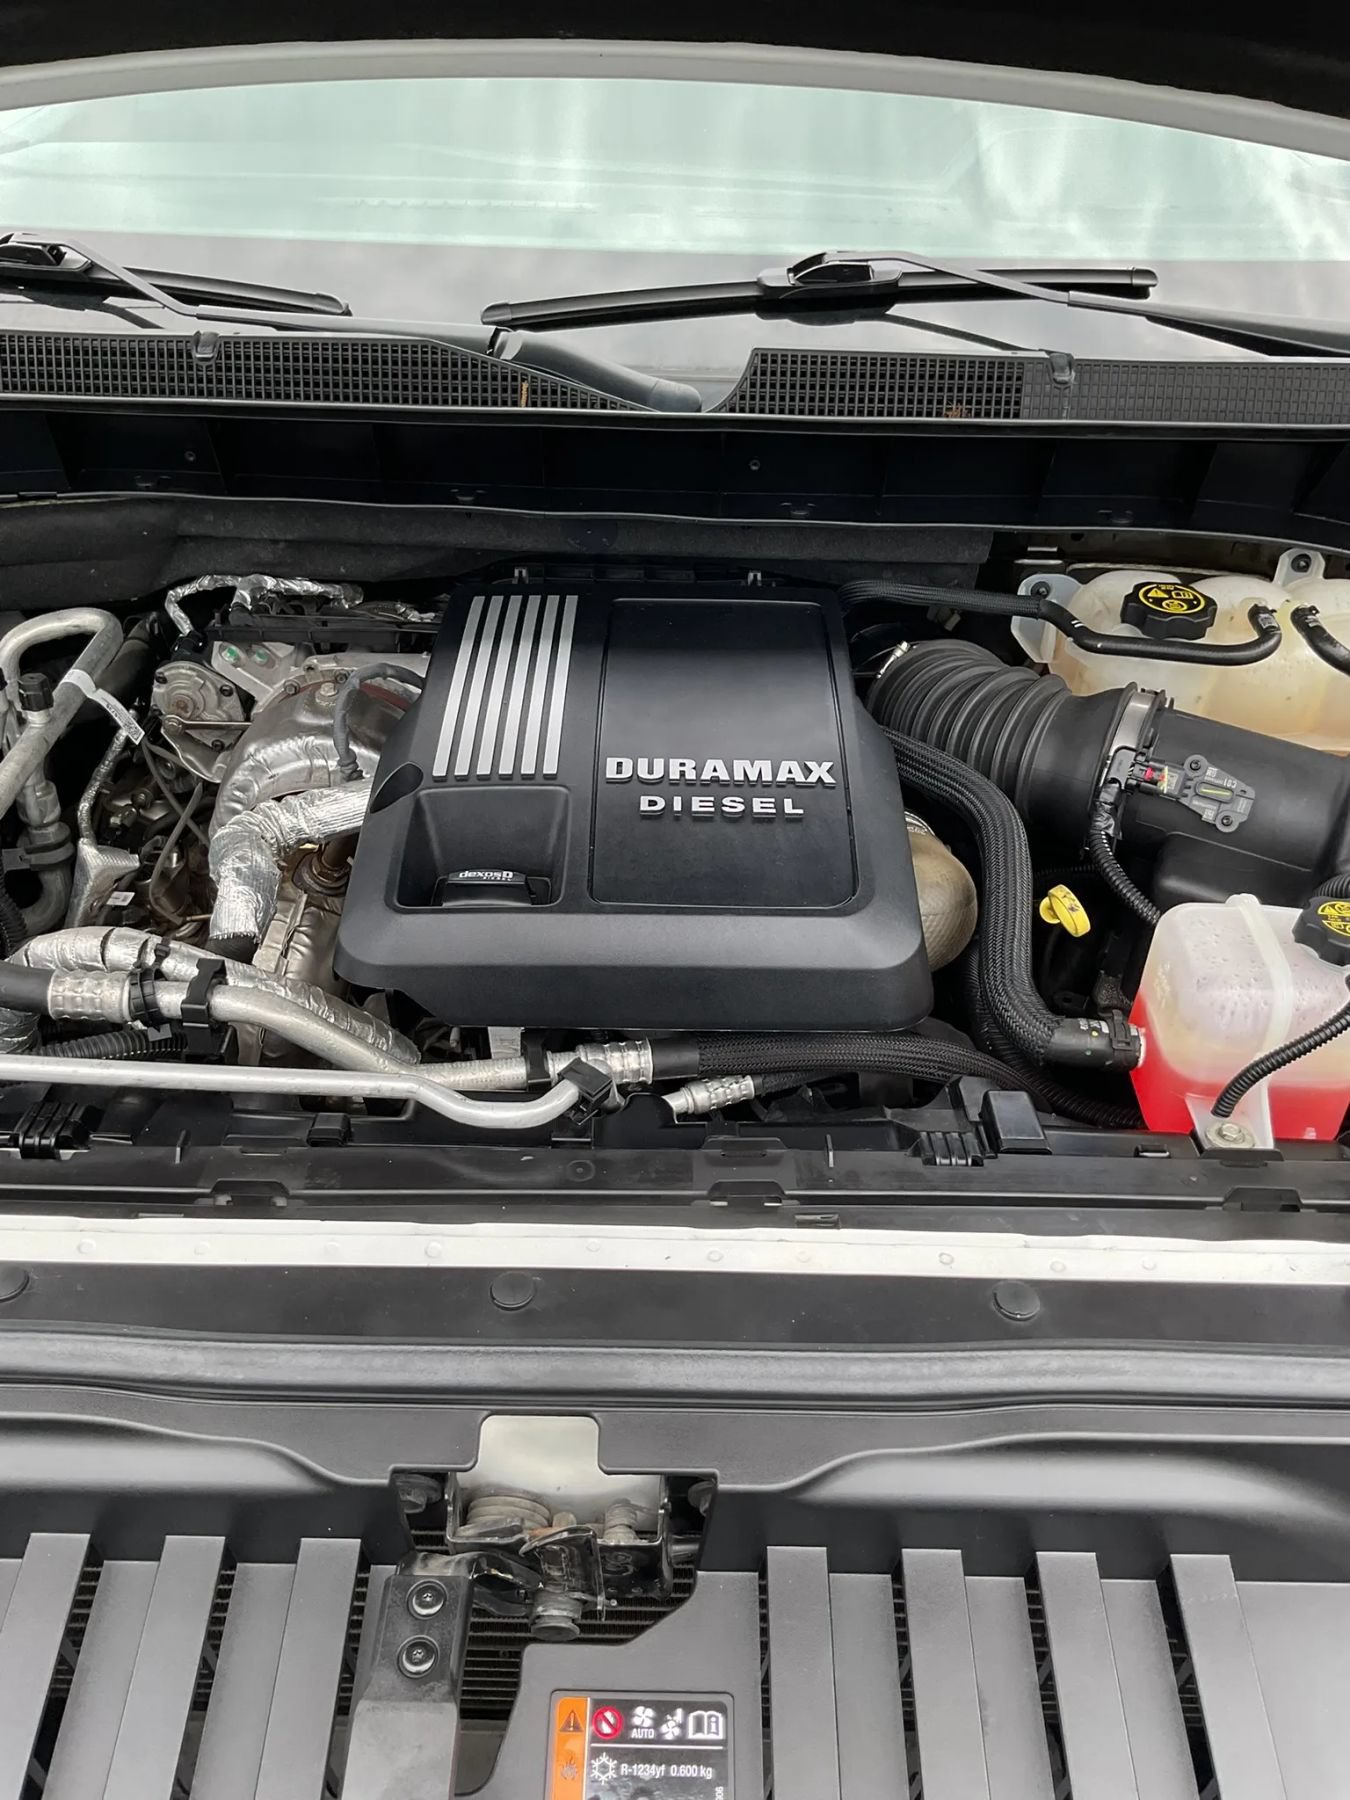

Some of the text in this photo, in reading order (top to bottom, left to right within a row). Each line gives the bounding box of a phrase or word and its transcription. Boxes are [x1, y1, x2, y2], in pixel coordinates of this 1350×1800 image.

[605, 756, 837, 787] DURAMAX
[639, 795, 805, 817] DIESEL
[631, 1728, 655, 1738] AUTO
[620, 1764, 713, 1779] R-1234yf 0.600 kg
